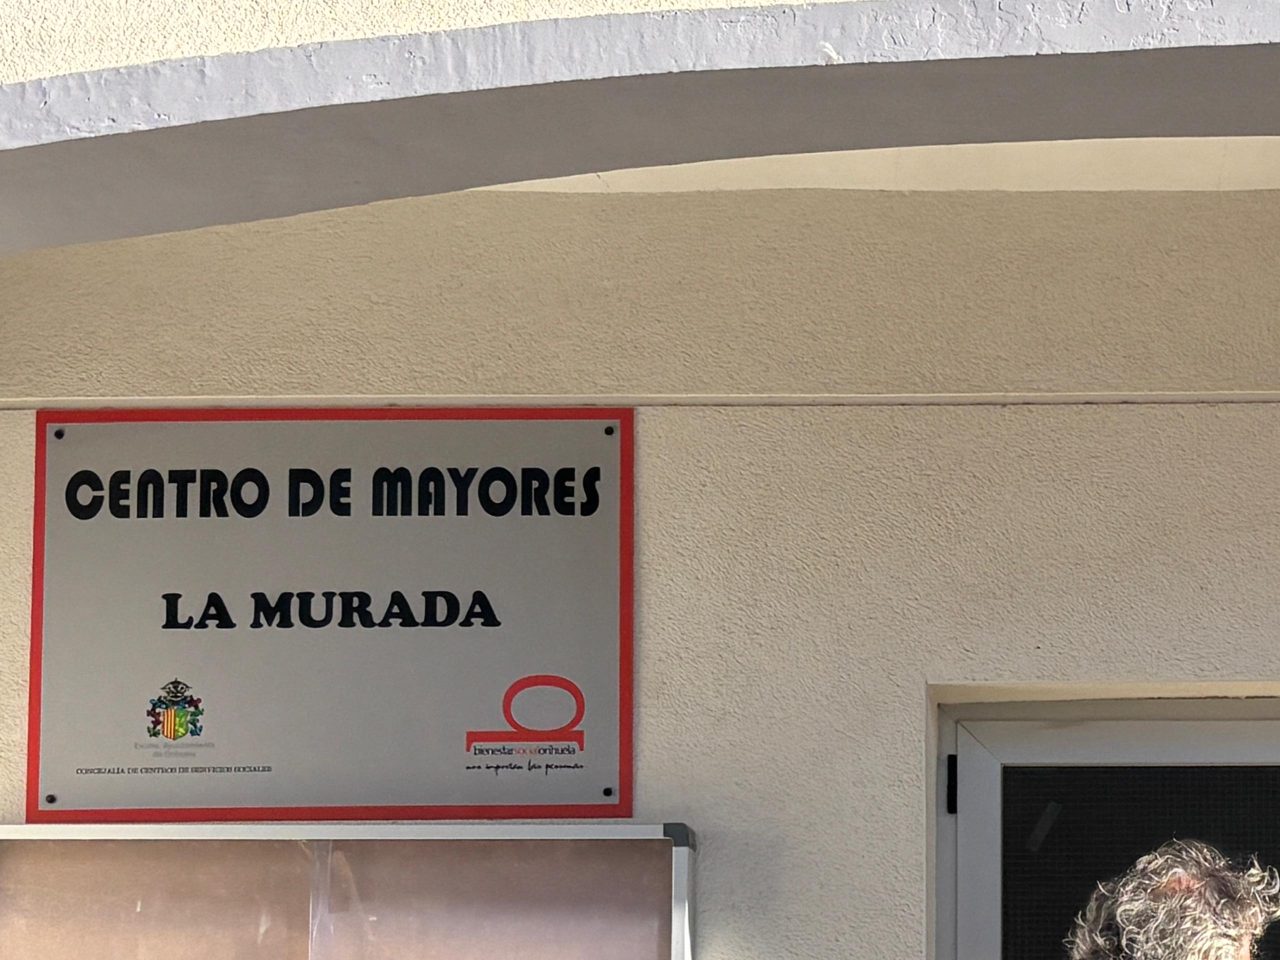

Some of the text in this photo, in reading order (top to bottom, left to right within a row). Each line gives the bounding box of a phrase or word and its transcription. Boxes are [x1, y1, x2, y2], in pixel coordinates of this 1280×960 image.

[65, 466, 601, 520] CENTRO DE MAYORES
[162, 590, 501, 630] LA MURADA
